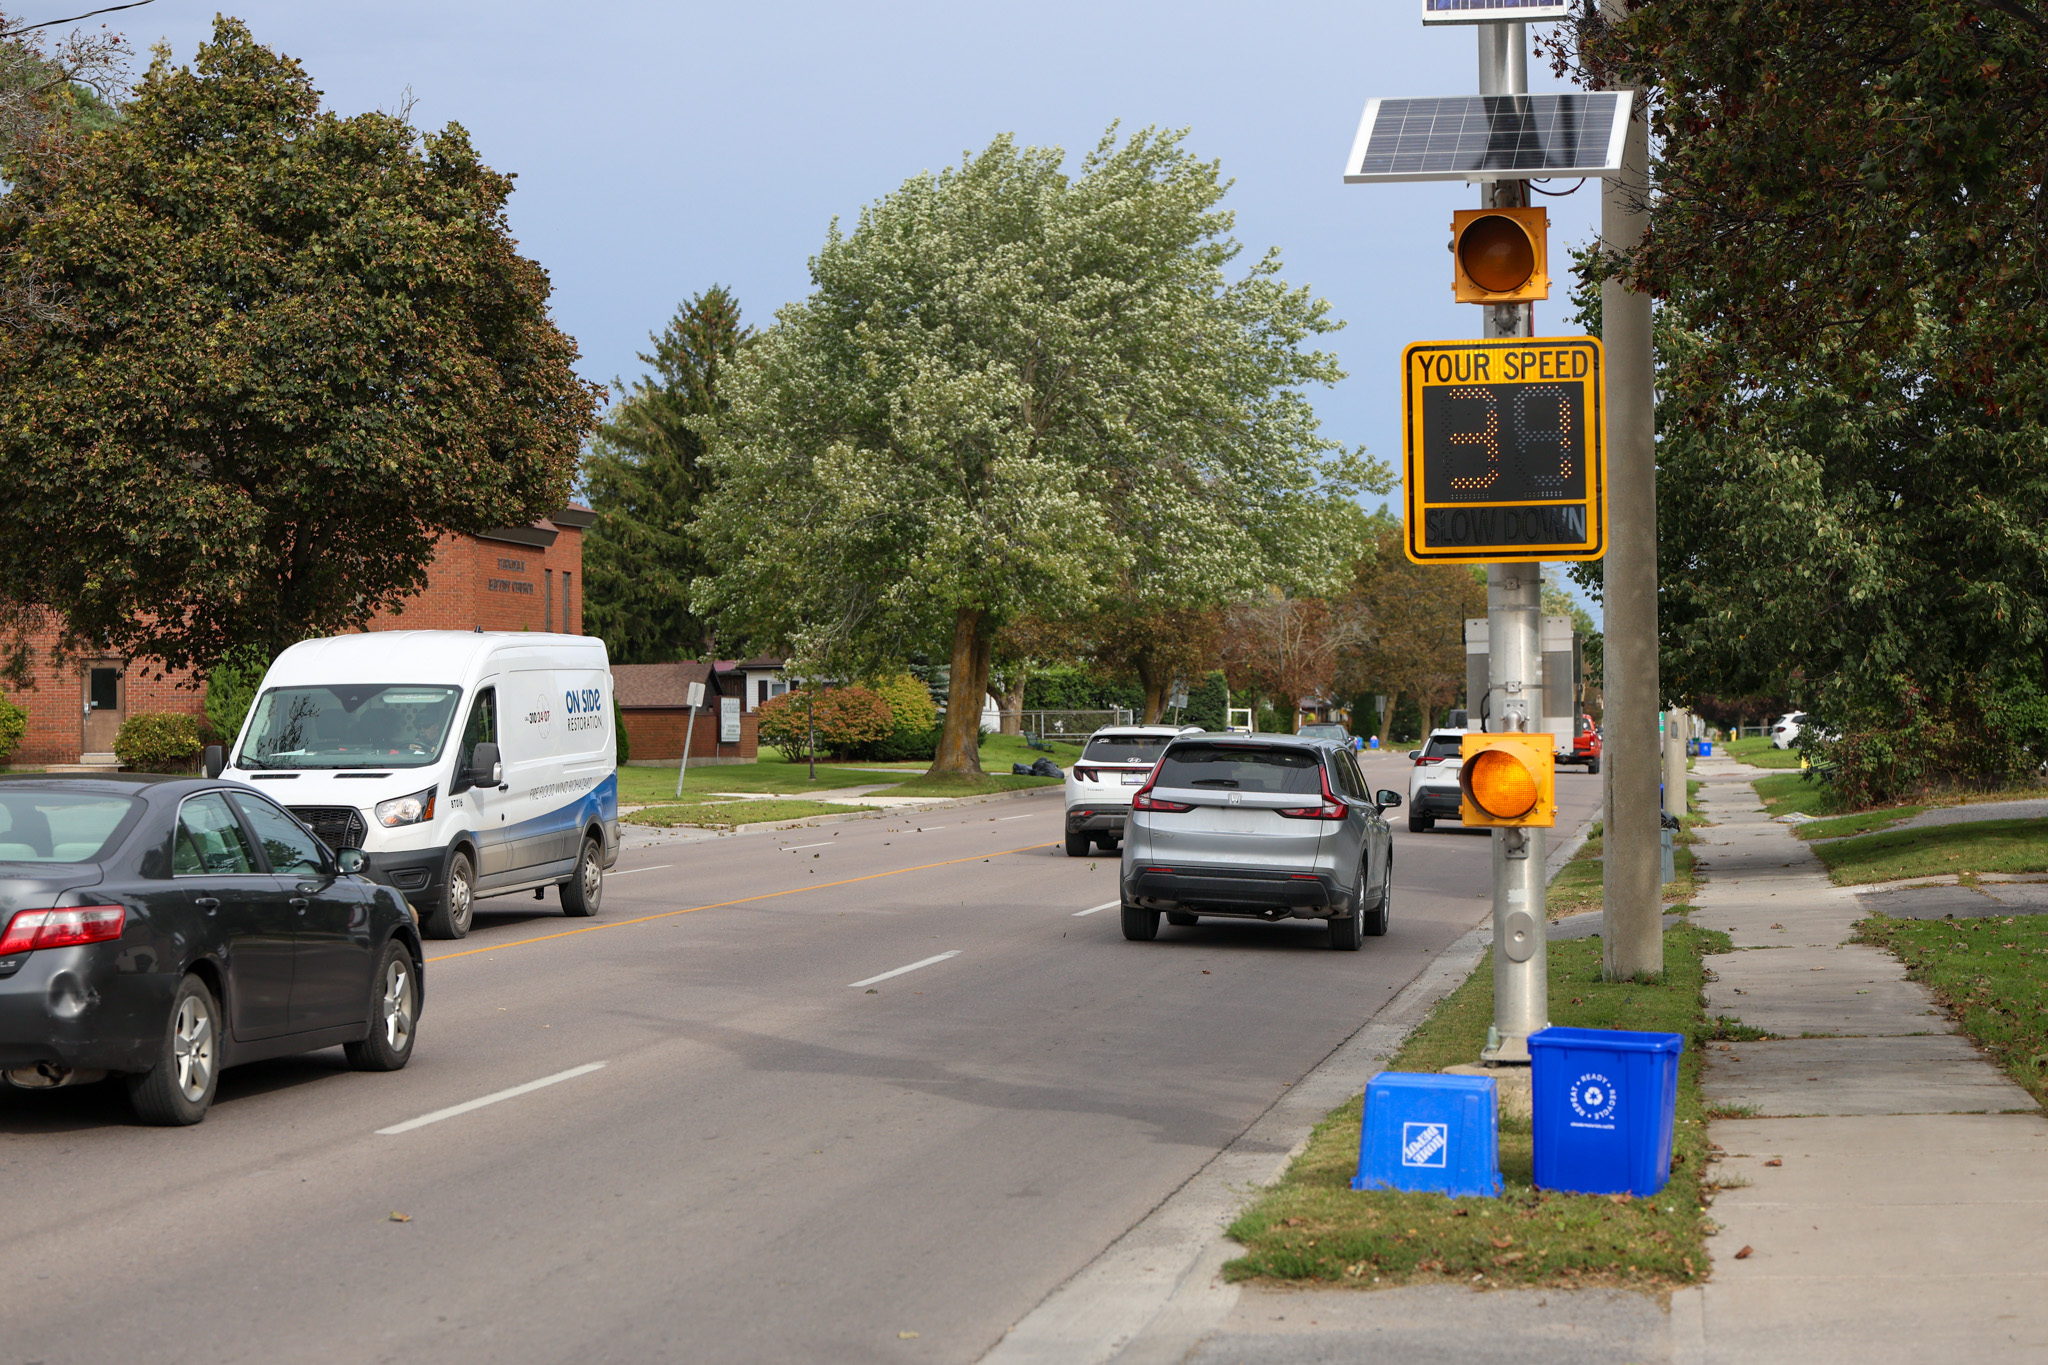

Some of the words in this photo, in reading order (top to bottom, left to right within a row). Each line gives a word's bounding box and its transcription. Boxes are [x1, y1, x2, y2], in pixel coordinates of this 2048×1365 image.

[1418, 353, 1490, 382] YOUR
[1504, 350, 1588, 380] SPEED
[1426, 508, 1498, 546] SLOW
[1504, 505, 1586, 543] DOWN
[566, 690, 580, 714] ON
[567, 716, 603, 732] RESTORATION
[1580, 1073, 1608, 1084] READY
[1570, 1086, 1586, 1117] REPEAT
[1595, 1089, 1617, 1120] RECYCLE
[1404, 1125, 1439, 1160] DEPOT
[1413, 1134, 1444, 1165] HOME
